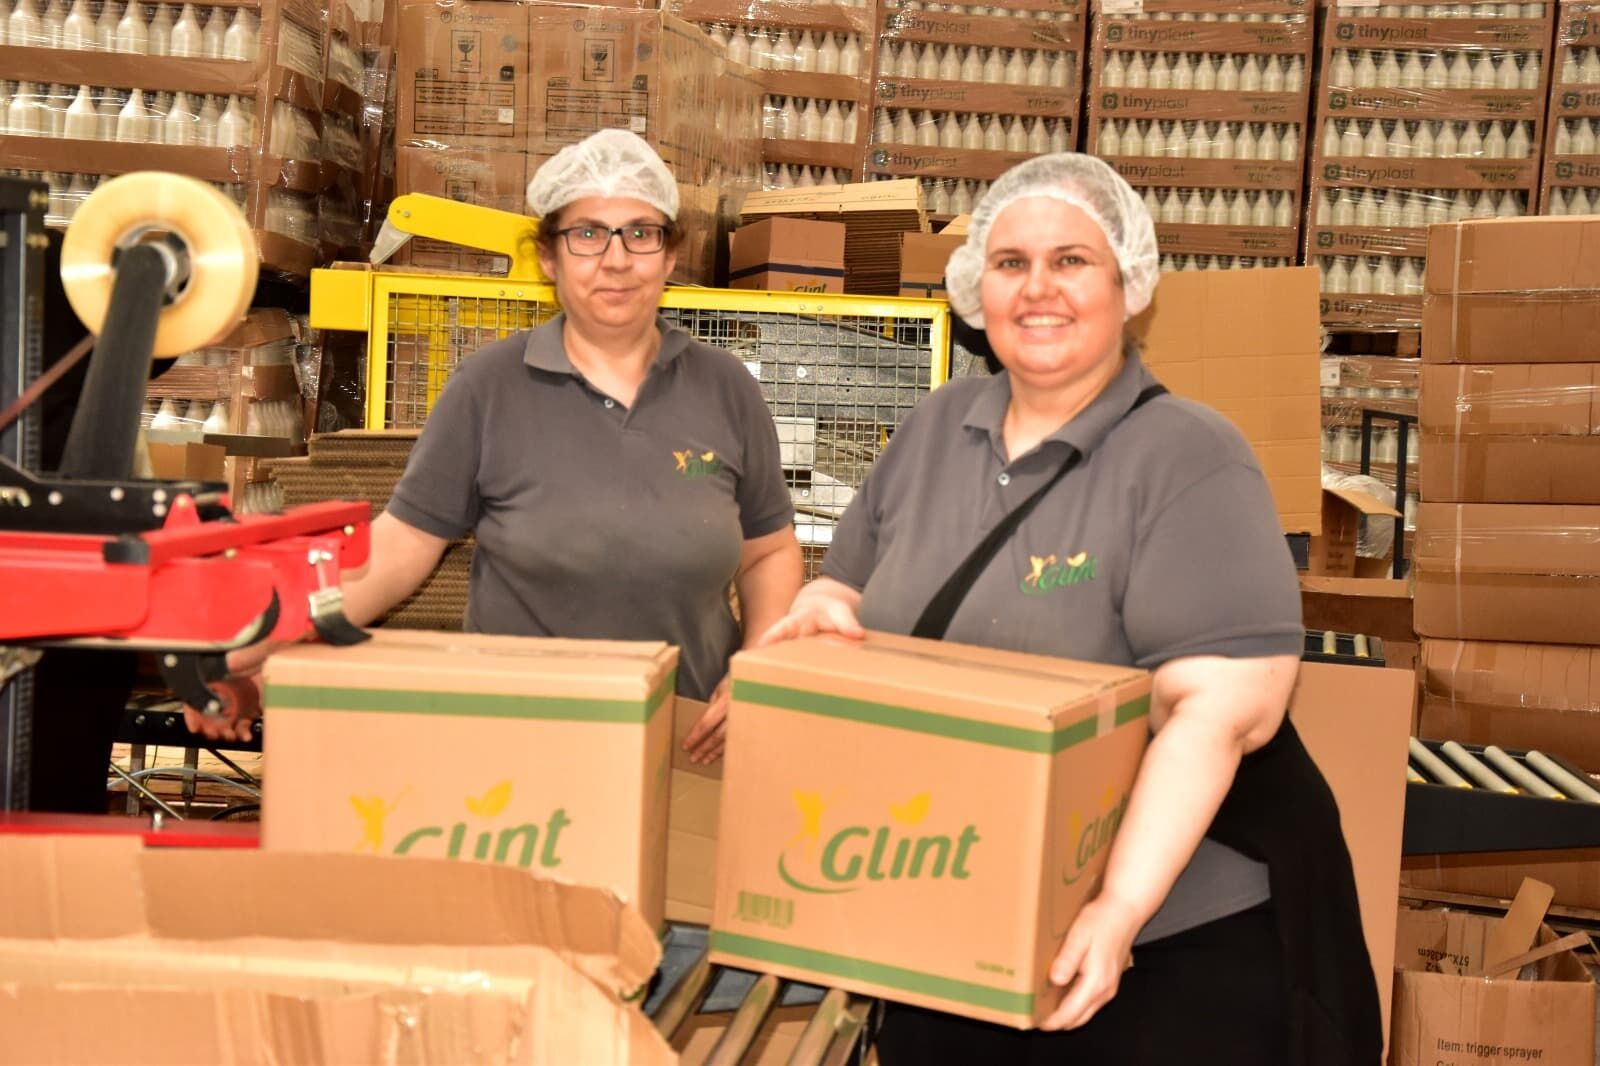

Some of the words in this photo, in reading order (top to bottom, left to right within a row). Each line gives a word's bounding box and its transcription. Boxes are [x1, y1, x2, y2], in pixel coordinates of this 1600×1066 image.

[1129, 27, 1195, 43] tinyplast
[1358, 24, 1428, 41] tinyplast
[900, 84, 966, 101] tinyplast
[1123, 96, 1188, 111] tinyplast
[893, 153, 957, 169] tinyplast
[1118, 164, 1184, 178] tinyplast
[1344, 164, 1415, 182] tinyplast
[820, 824, 981, 883] Glint
[1437, 1038, 1464, 1052] Item:
[1466, 1041, 1501, 1058] trigger
[1503, 1046, 1543, 1062] sprayer
